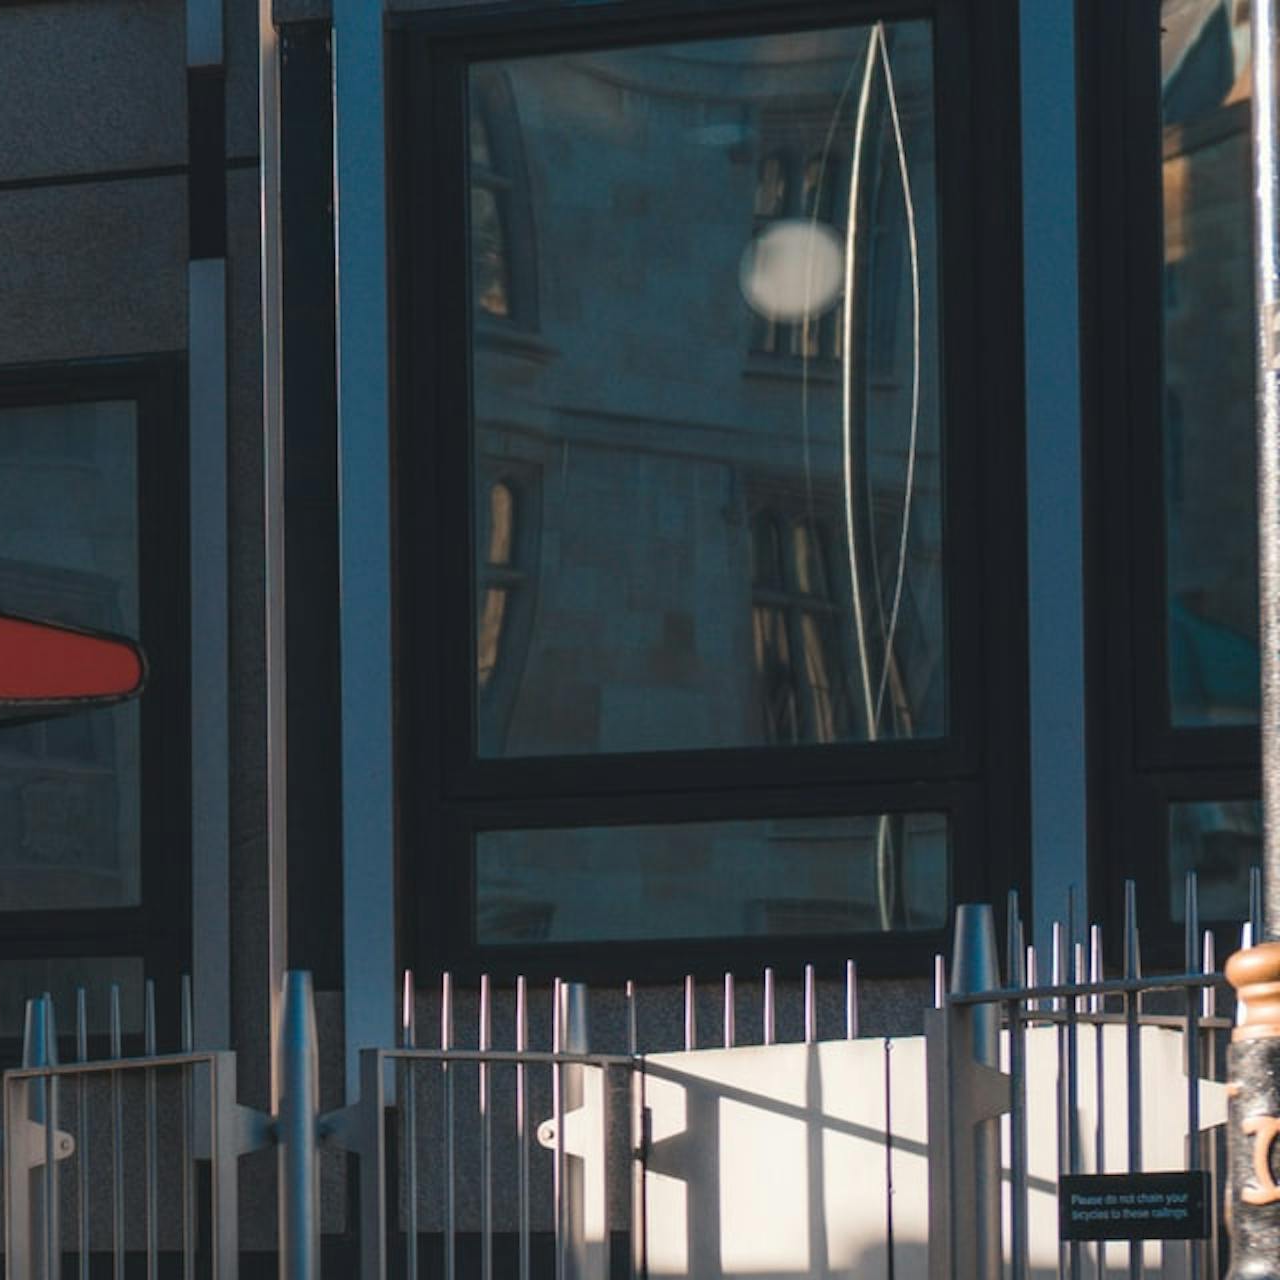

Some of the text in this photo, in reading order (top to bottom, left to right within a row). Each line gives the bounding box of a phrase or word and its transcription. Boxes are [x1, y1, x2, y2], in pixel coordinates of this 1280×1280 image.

[1071, 1193, 1103, 1206] Please
[1105, 1194, 1118, 1205] do
[1119, 1194, 1135, 1205] not
[1111, 1209, 1121, 1220] to
